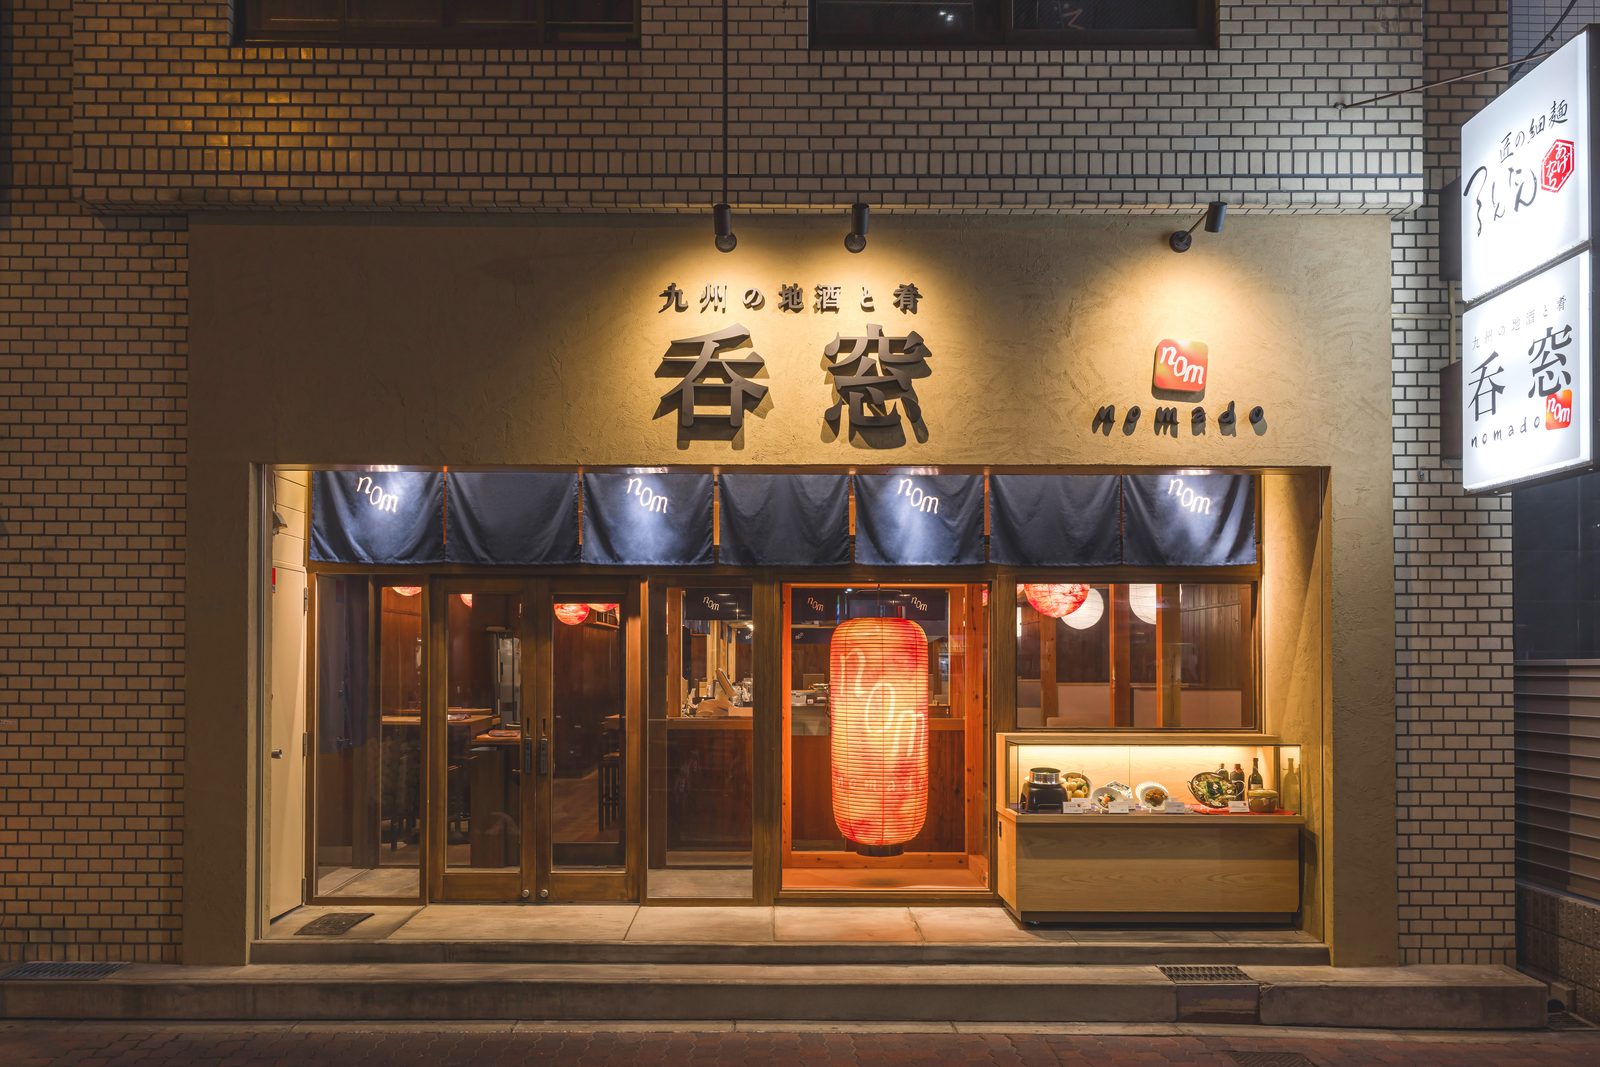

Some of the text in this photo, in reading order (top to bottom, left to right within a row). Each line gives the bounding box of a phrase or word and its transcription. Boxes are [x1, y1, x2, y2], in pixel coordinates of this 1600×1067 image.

[1500, 99, 1568, 164] 匠の細麺
[660, 282, 921, 313] 九州の地酒と肴
[1471, 295, 1567, 351] 九州の地酒と肴
[657, 322, 928, 436] 呑窓
[1159, 346, 1204, 385] nom
[1467, 324, 1573, 422] 呑窓
[1094, 401, 1266, 433] nomado
[1547, 397, 1571, 424] nom
[1471, 416, 1541, 448] nomado
[356, 476, 399, 513] nom
[626, 477, 668, 514] nom
[897, 478, 940, 515] nom
[1167, 478, 1211, 515] nom
[703, 596, 720, 611] nom
[807, 596, 824, 612] nom
[911, 596, 928, 612] nom
[840, 648, 925, 768] nom
